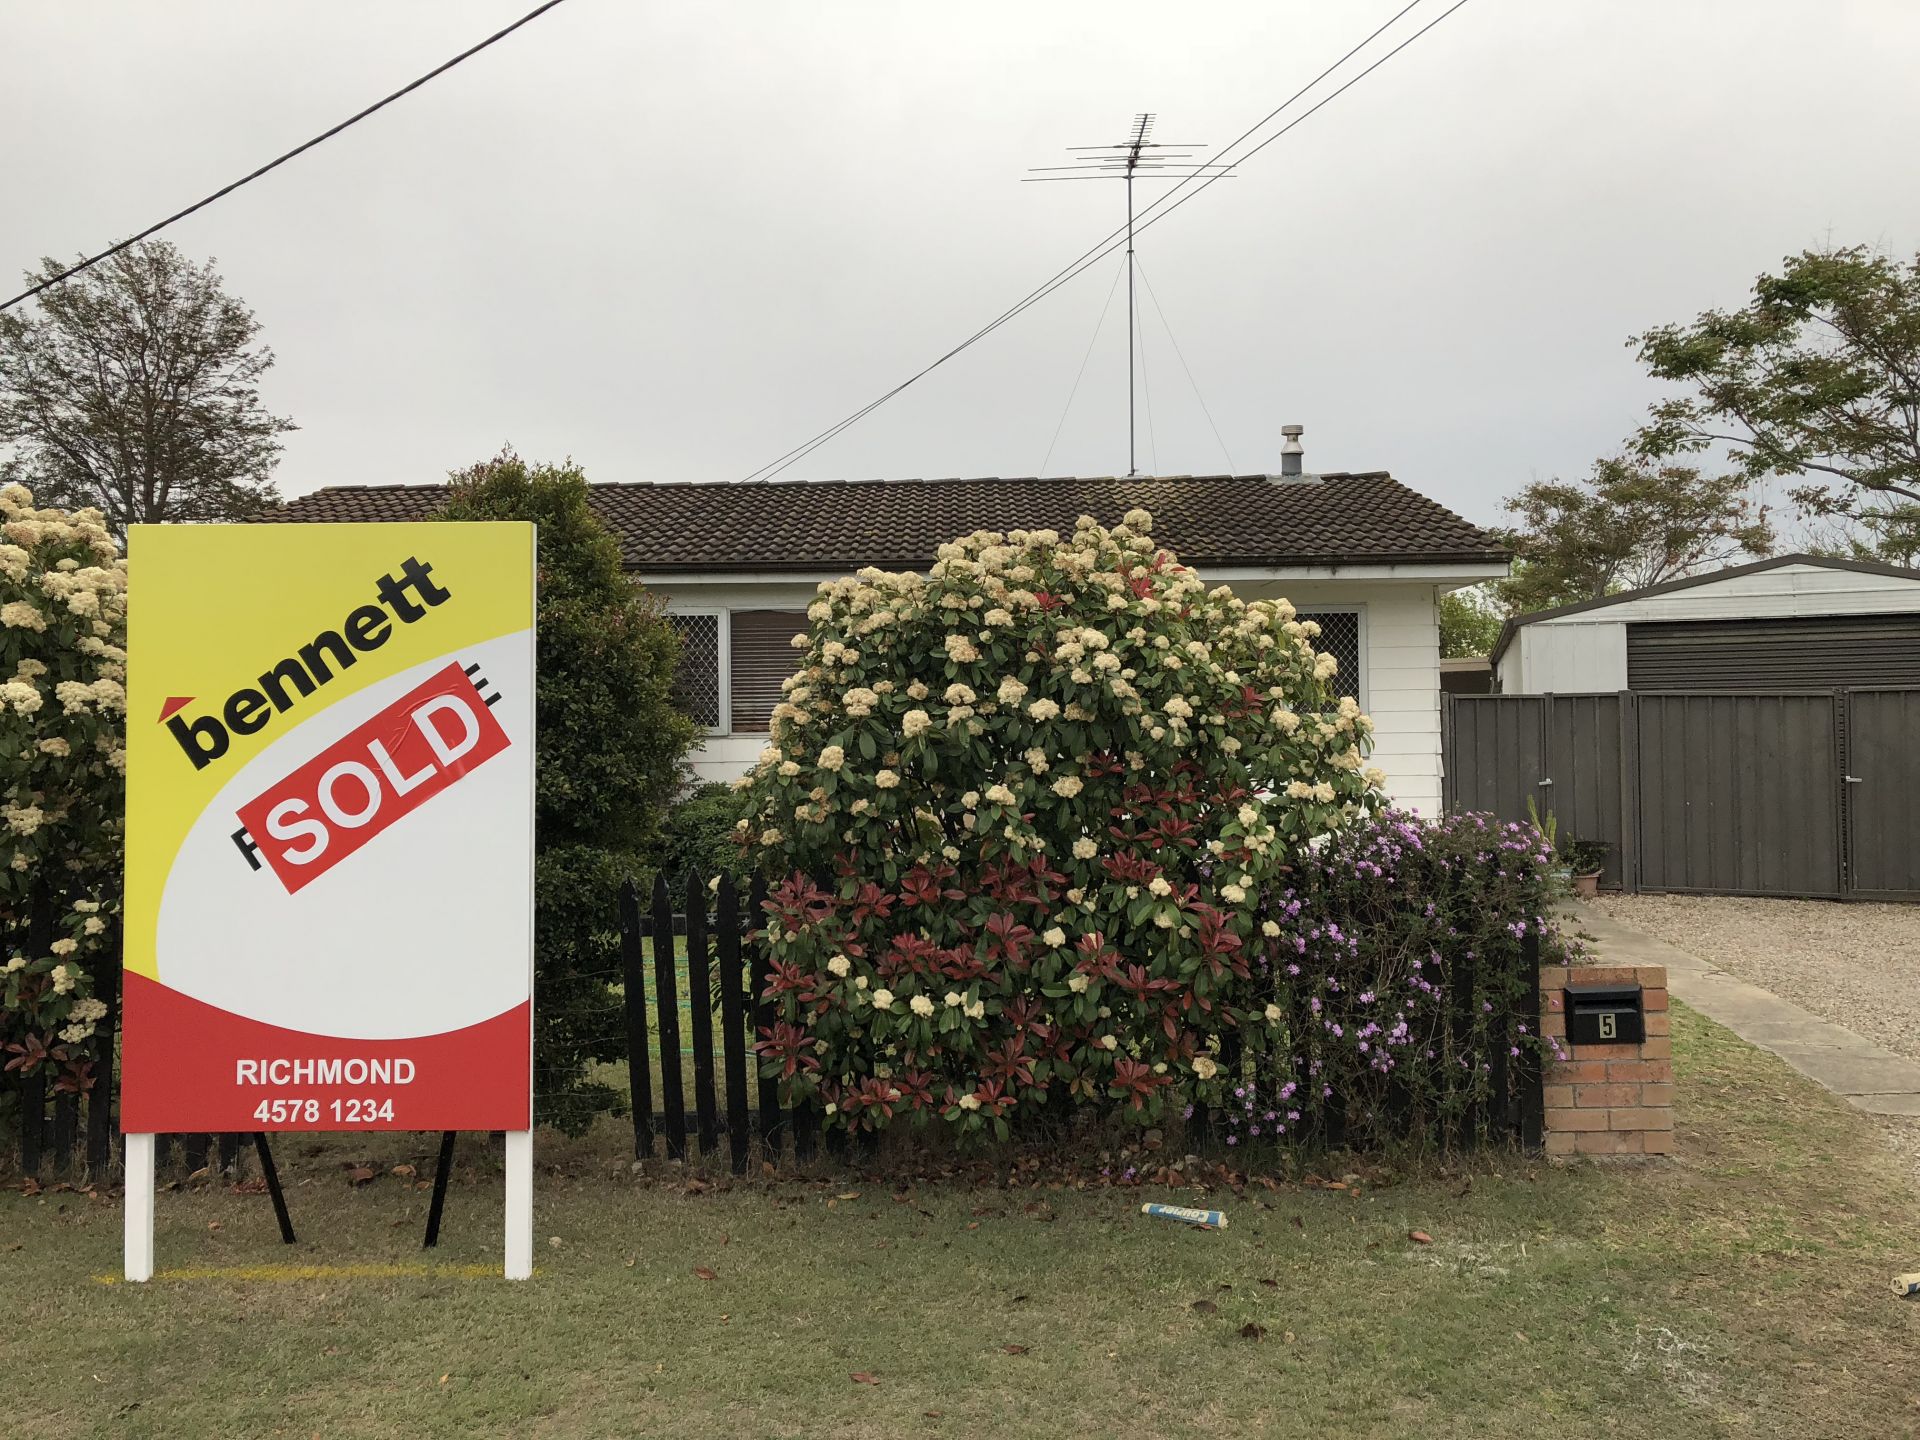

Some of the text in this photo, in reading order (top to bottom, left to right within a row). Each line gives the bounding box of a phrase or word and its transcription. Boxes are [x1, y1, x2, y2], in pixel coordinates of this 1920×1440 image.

[165, 556, 451, 771] bennett
[265, 694, 480, 865] SOLD
[1602, 1015, 1613, 1036] 5
[236, 1058, 416, 1085] RICHMOND
[253, 1098, 395, 1123] 4578 1234
